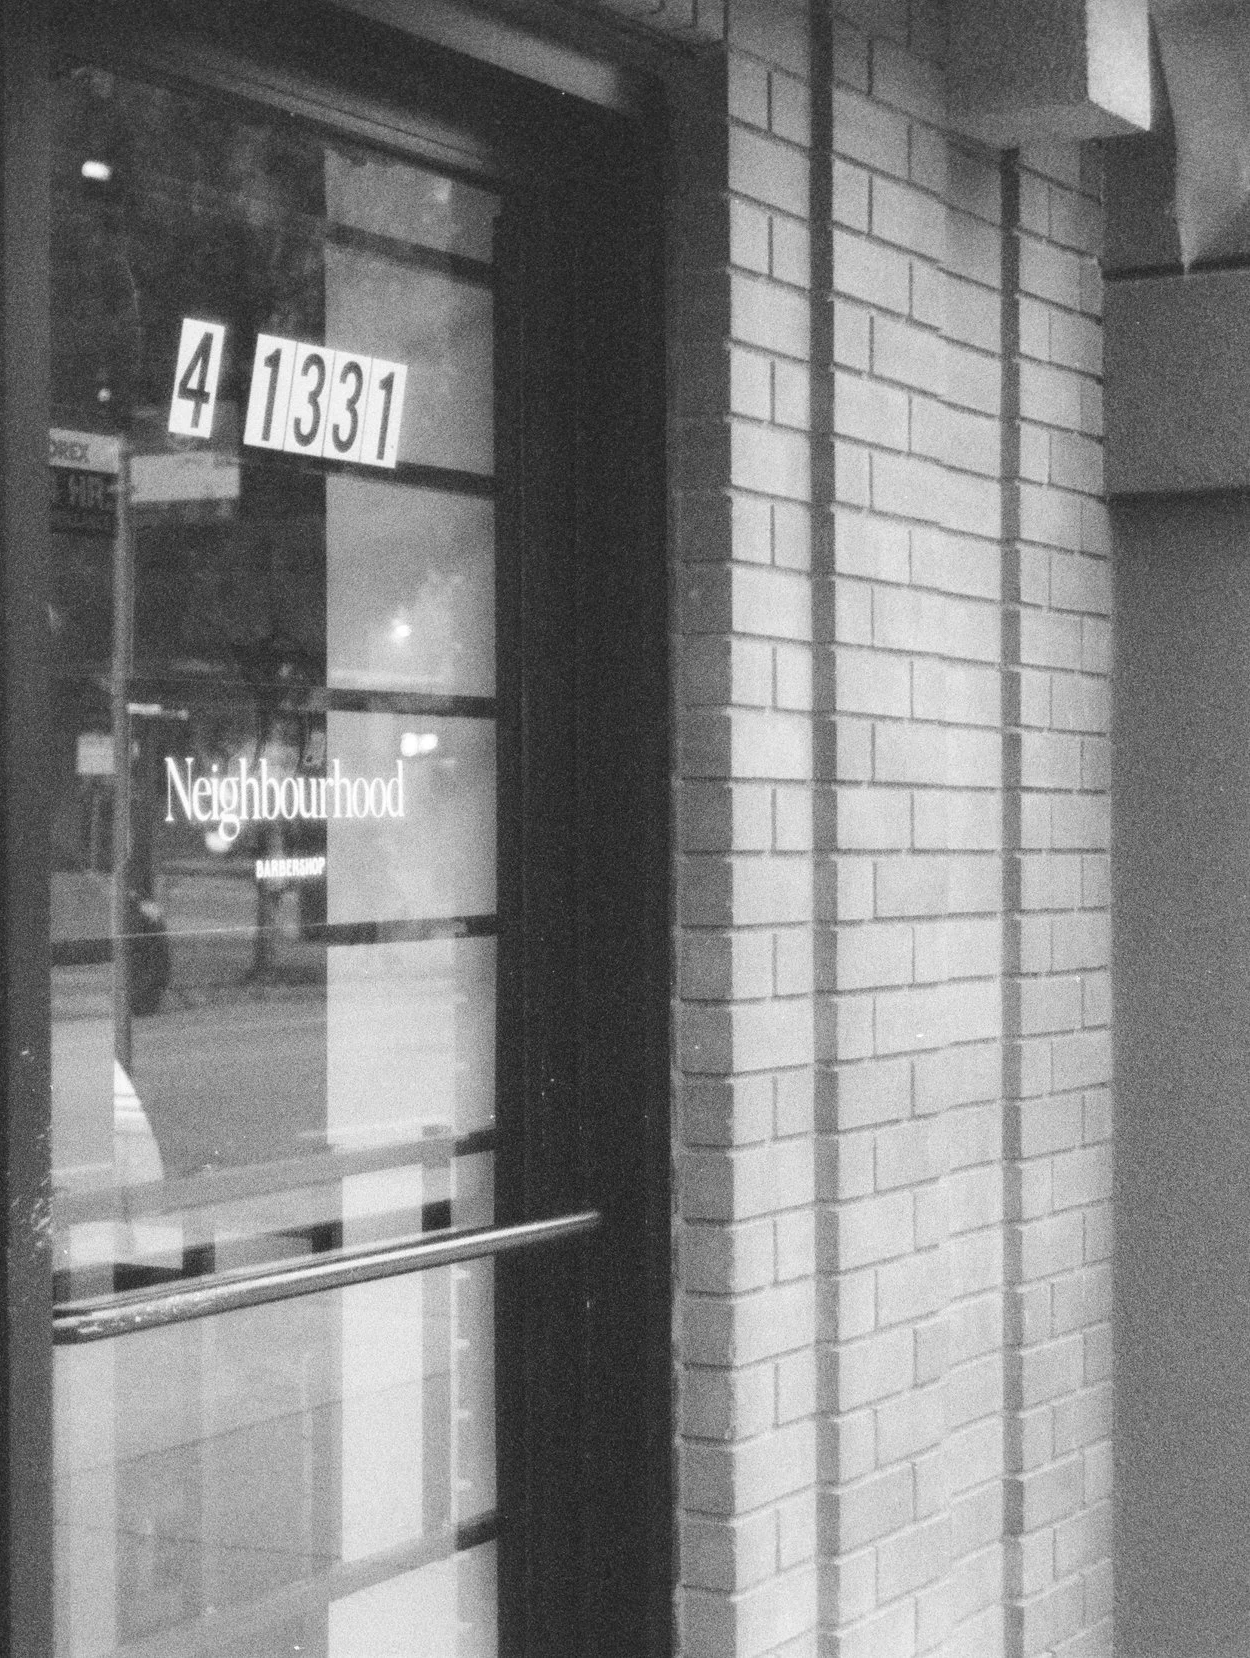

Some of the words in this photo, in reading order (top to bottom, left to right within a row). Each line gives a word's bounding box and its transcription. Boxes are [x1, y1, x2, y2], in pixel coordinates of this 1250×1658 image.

[177, 331, 214, 430] 4
[261, 347, 396, 462] 1331
[164, 756, 406, 841] Neighbourhood
[256, 857, 326, 878] BARBERSHOP
